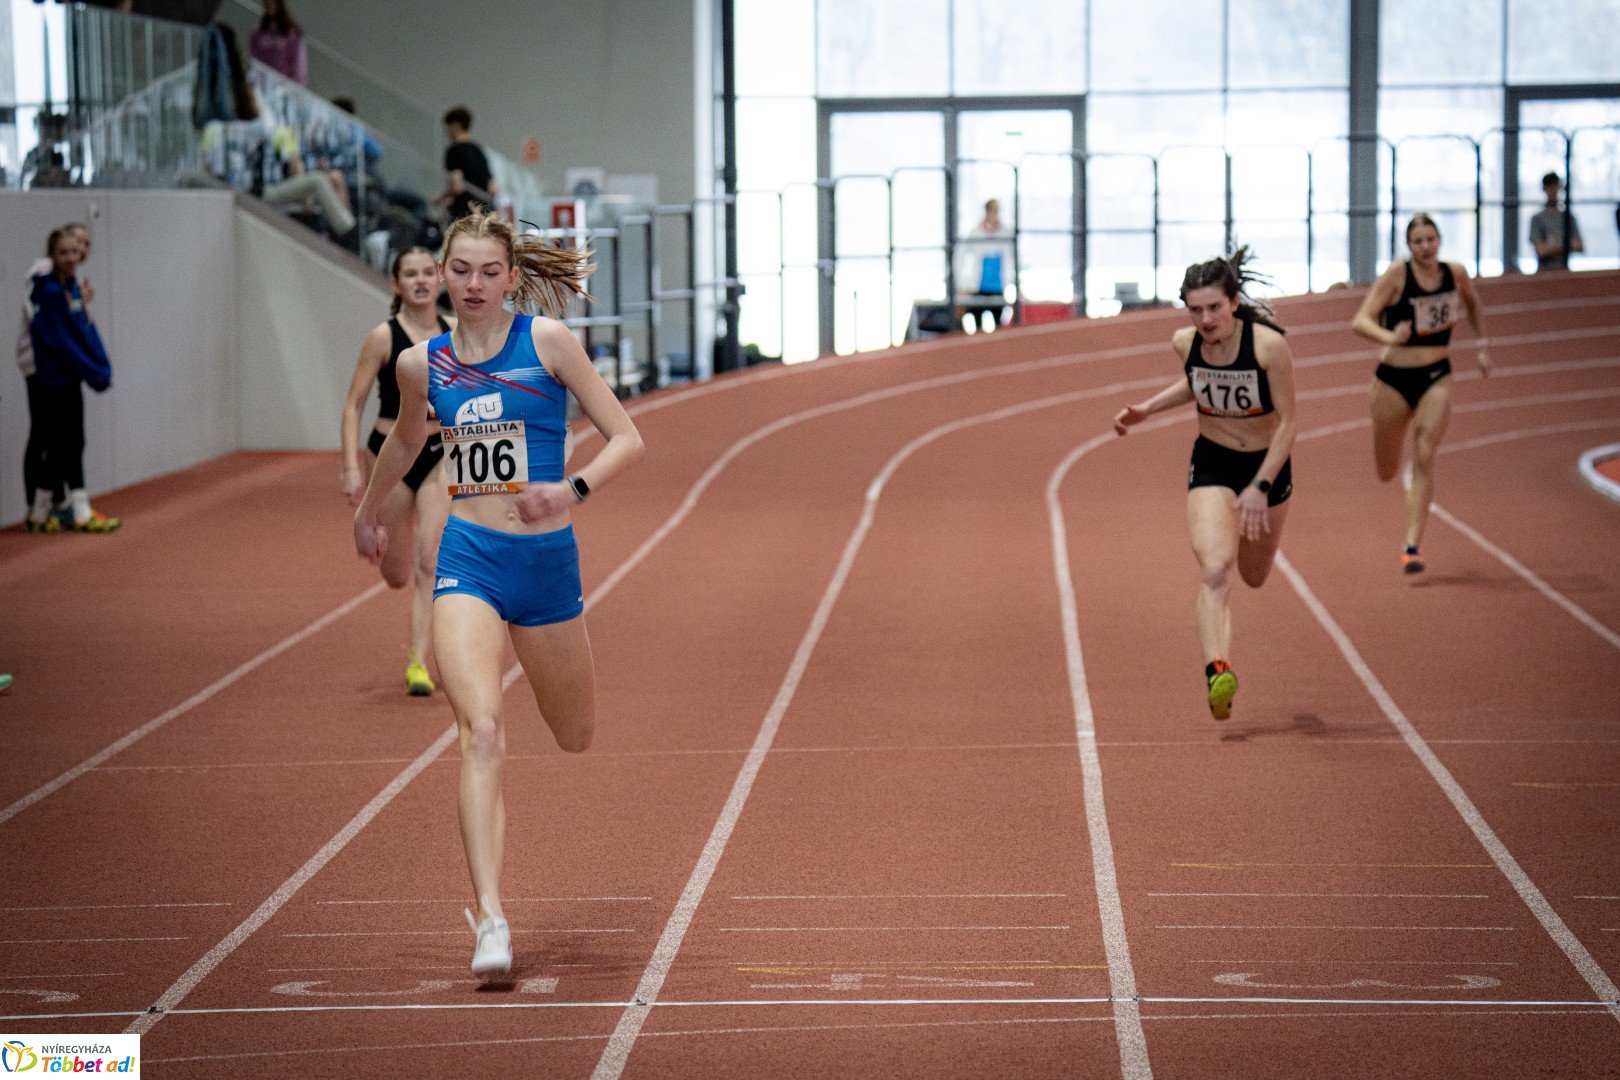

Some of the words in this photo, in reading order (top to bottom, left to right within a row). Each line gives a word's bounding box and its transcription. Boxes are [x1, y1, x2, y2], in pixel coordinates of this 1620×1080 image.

[1201, 383, 1252, 410] 176
[452, 422, 518, 436] STABILITA
[449, 439, 516, 484] 106
[457, 484, 508, 494] ATLETIKA
